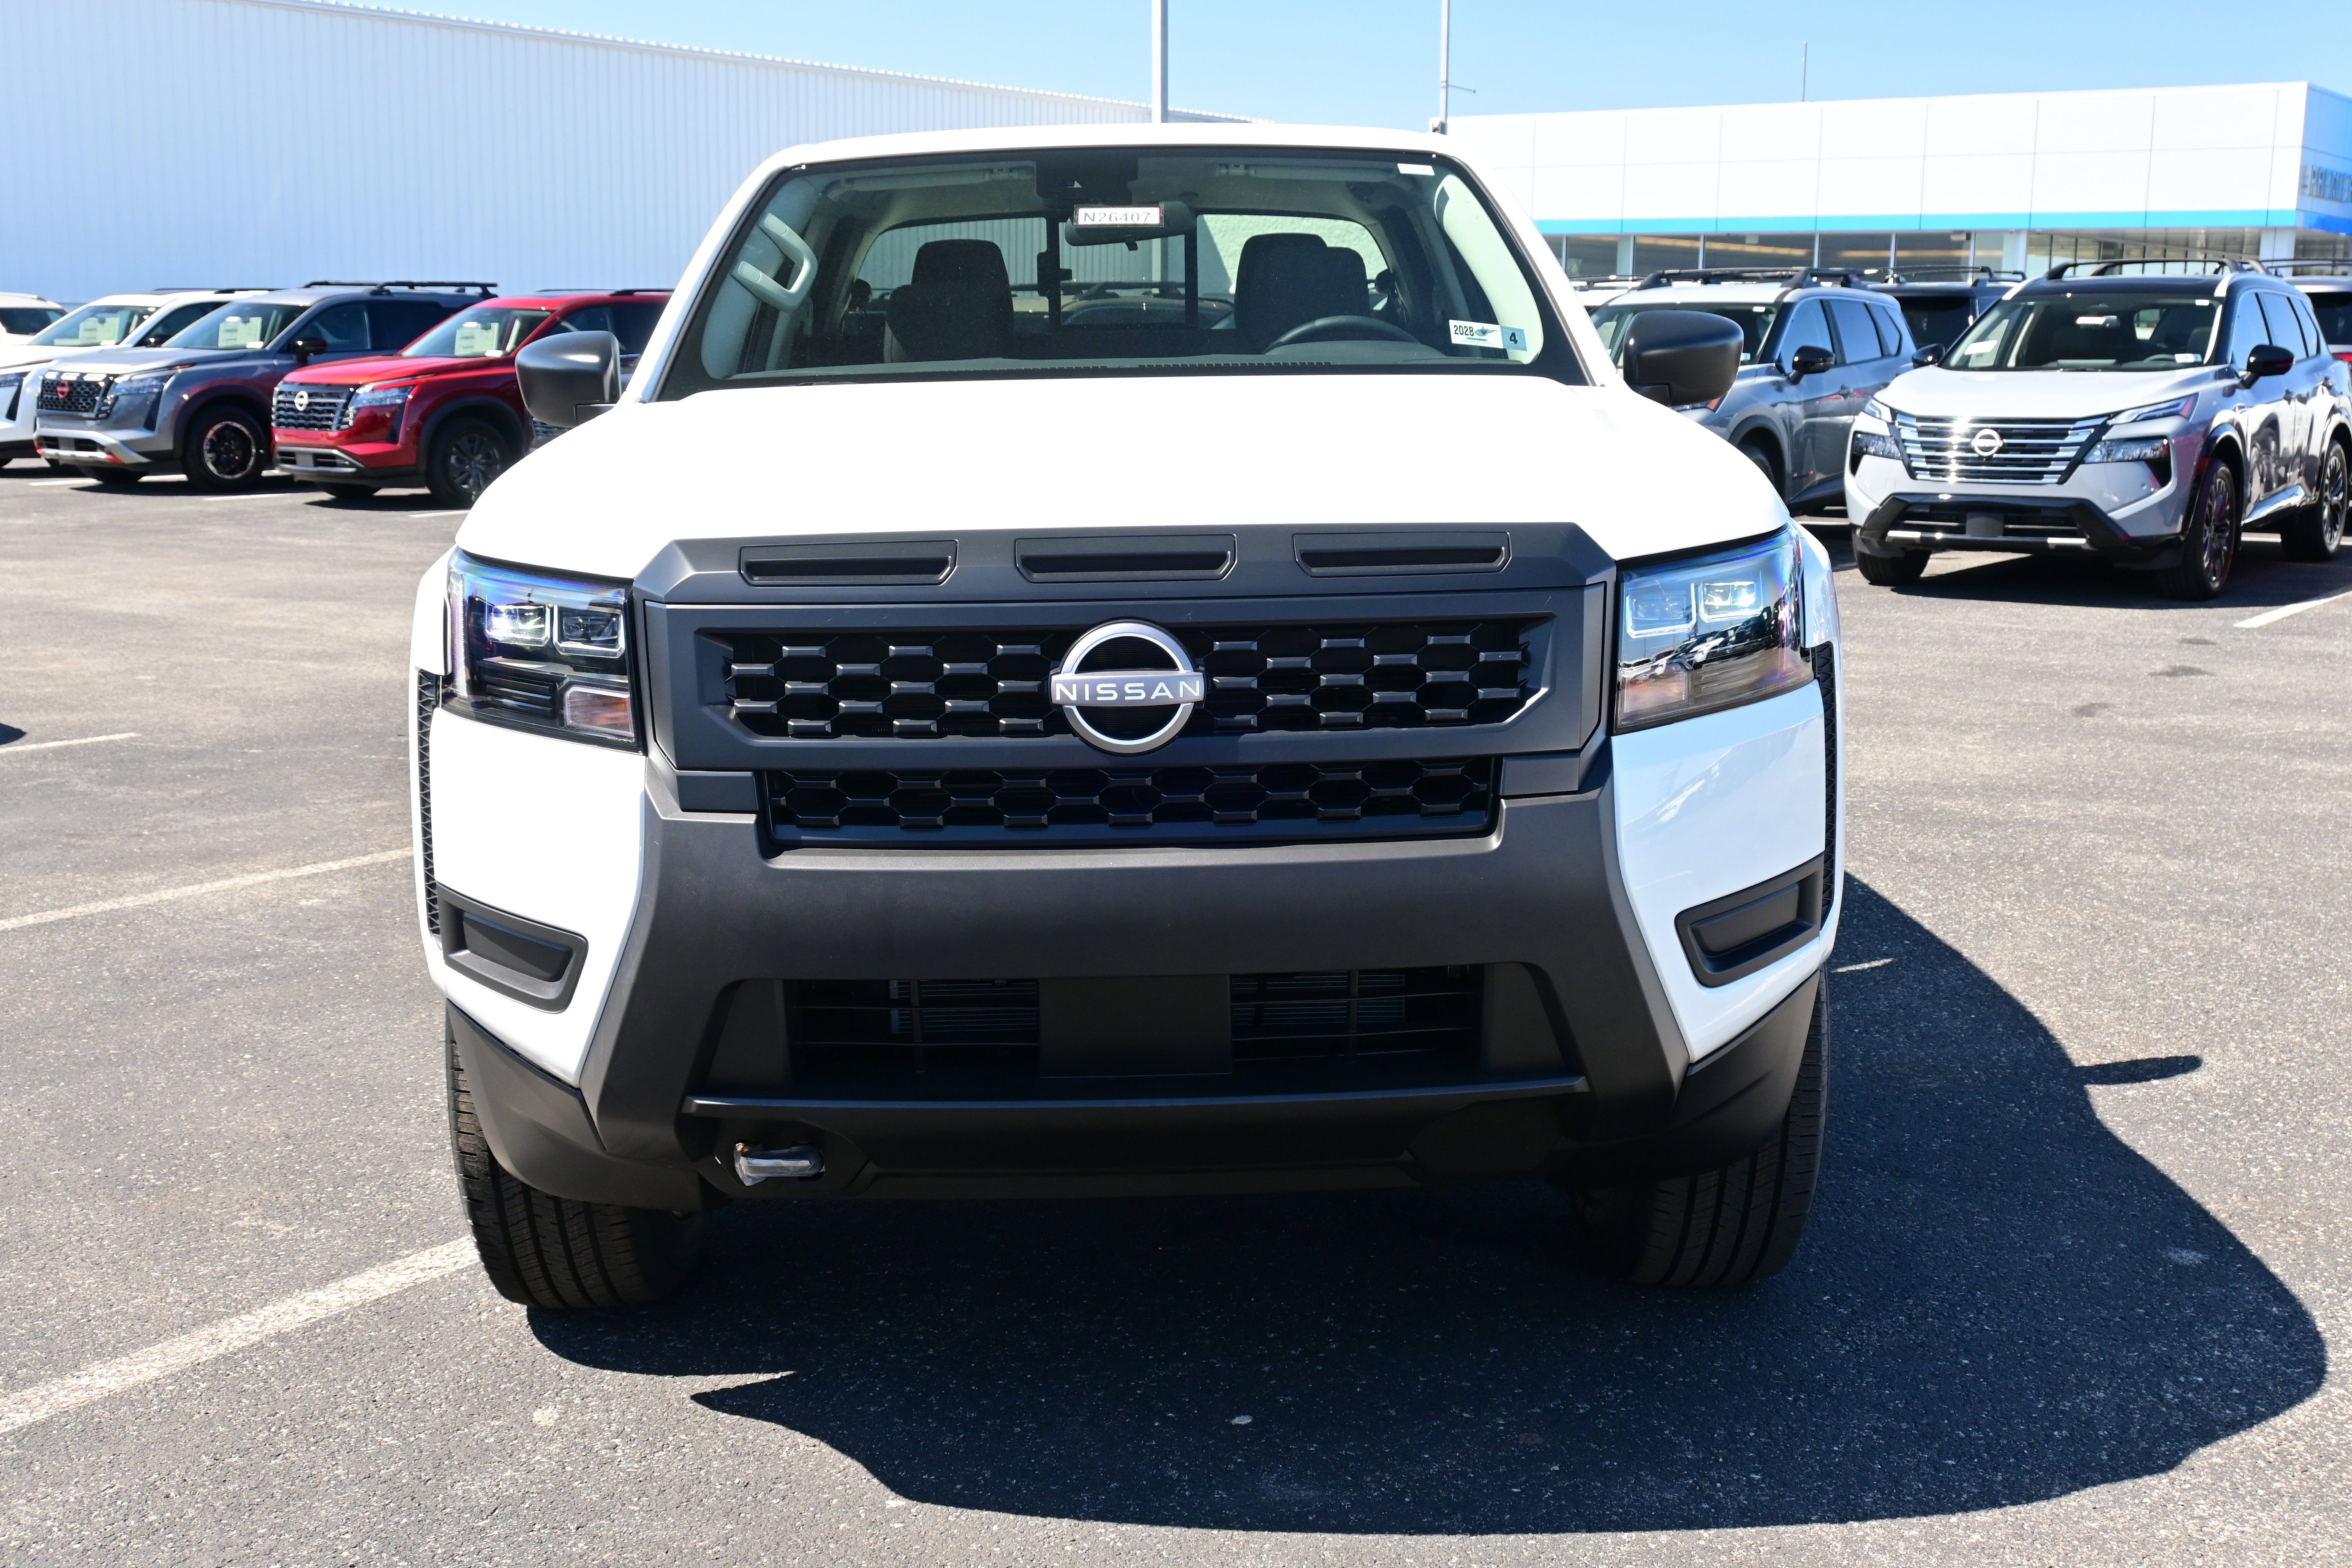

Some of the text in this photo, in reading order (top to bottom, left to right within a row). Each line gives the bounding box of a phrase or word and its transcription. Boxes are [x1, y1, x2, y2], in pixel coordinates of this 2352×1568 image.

[1084, 212, 1151, 222] N26407
[1454, 325, 1474, 336] 2028
[1509, 332, 1518, 344] 4
[1055, 680, 1200, 701] NISSAN
